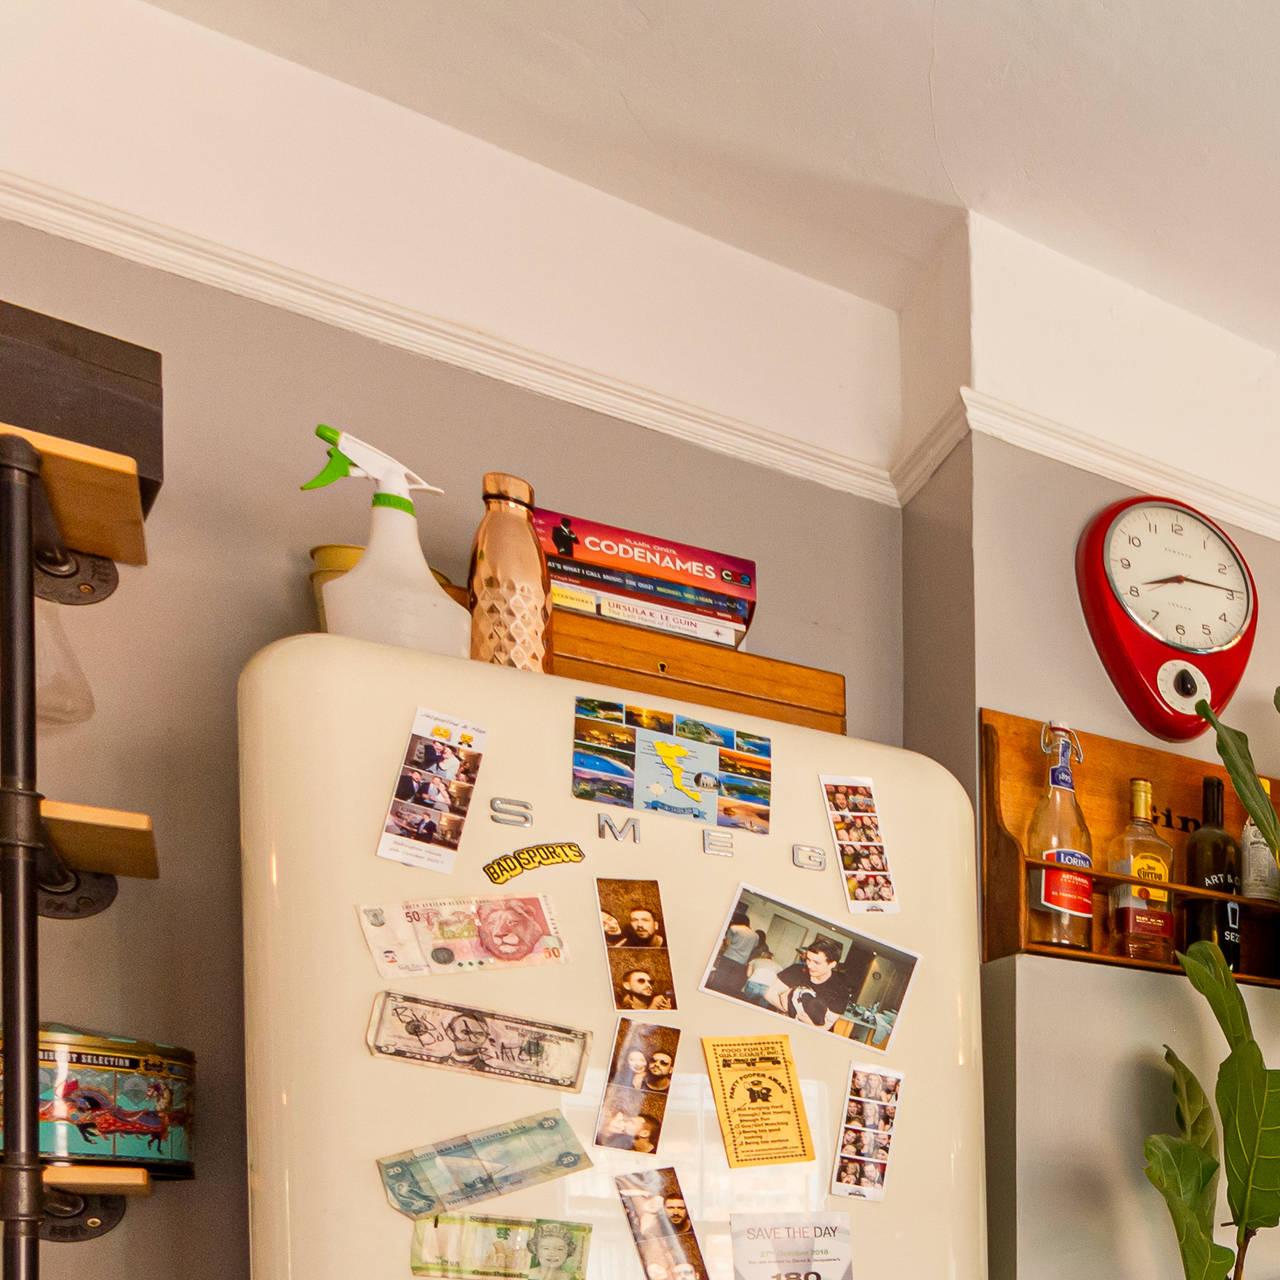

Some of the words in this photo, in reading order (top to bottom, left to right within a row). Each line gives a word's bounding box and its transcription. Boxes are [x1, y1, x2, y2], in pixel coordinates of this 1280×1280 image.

[1148, 522, 1158, 534] 11
[1171, 522, 1183, 536] 12
[1128, 535, 1142, 547] 10
[584, 536, 716, 580] CODENAMES
[1121, 557, 1131, 569] 9
[1218, 562, 1227, 575] 2
[1129, 585, 1140, 598] 8
[1226, 589, 1235, 600] 3
[607, 601, 647, 617] URSULA
[660, 613, 670, 622] LE
[673, 617, 697, 629] GUIN
[1151, 609, 1159, 620] 7
[1218, 612, 1227, 622] 4
[1175, 624, 1186, 635] 6
[1201, 624, 1211, 635] 5
[486, 856, 519, 882] BAD
[516, 844, 582, 868] SPORTS
[1204, 873, 1224, 887] ART
[405, 910, 421, 923] 50
[543, 946, 561, 960] 50
[81, 1054, 130, 1067] SELECTION
[541, 1119, 557, 1129] 20
[561, 1154, 575, 1164] 20
[386, 1166, 402, 1177] 20
[746, 1227, 780, 1240] SAVE
[784, 1226, 811, 1239] THE
[813, 1226, 838, 1239] DAY
